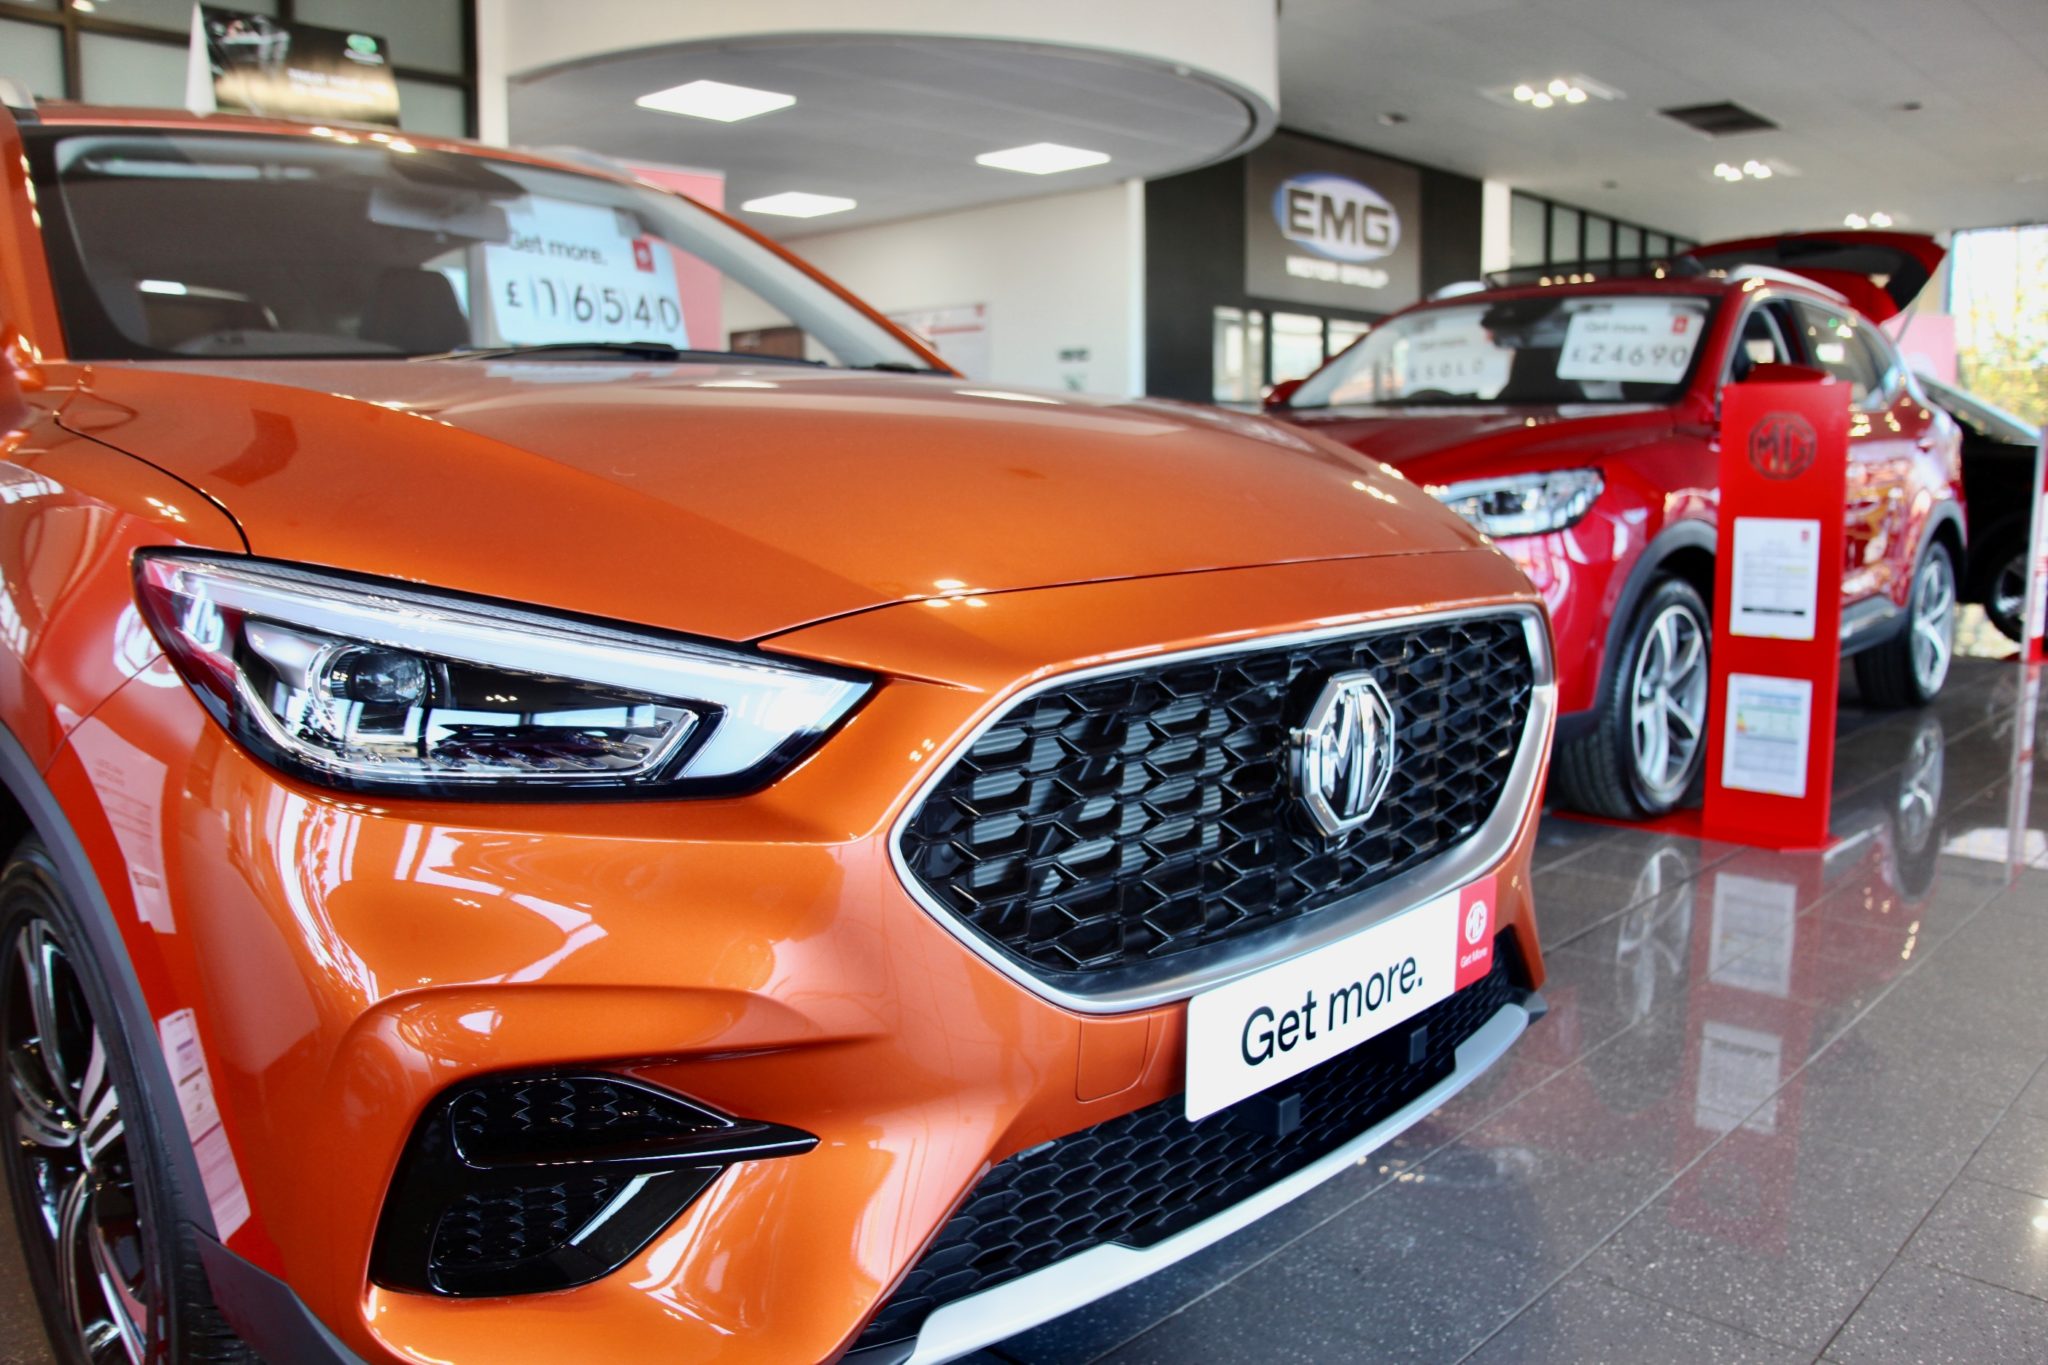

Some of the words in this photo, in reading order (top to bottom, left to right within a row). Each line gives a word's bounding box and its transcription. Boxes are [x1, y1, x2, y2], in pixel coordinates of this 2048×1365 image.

[510, 229, 545, 256] Get
[549, 240, 609, 266] more.
[1287, 185, 1391, 249] EMG
[1753, 413, 1812, 476] MG
[1314, 675, 1391, 824] MG
[1241, 989, 1317, 1067] Get
[1327, 956, 1423, 1033] more.
